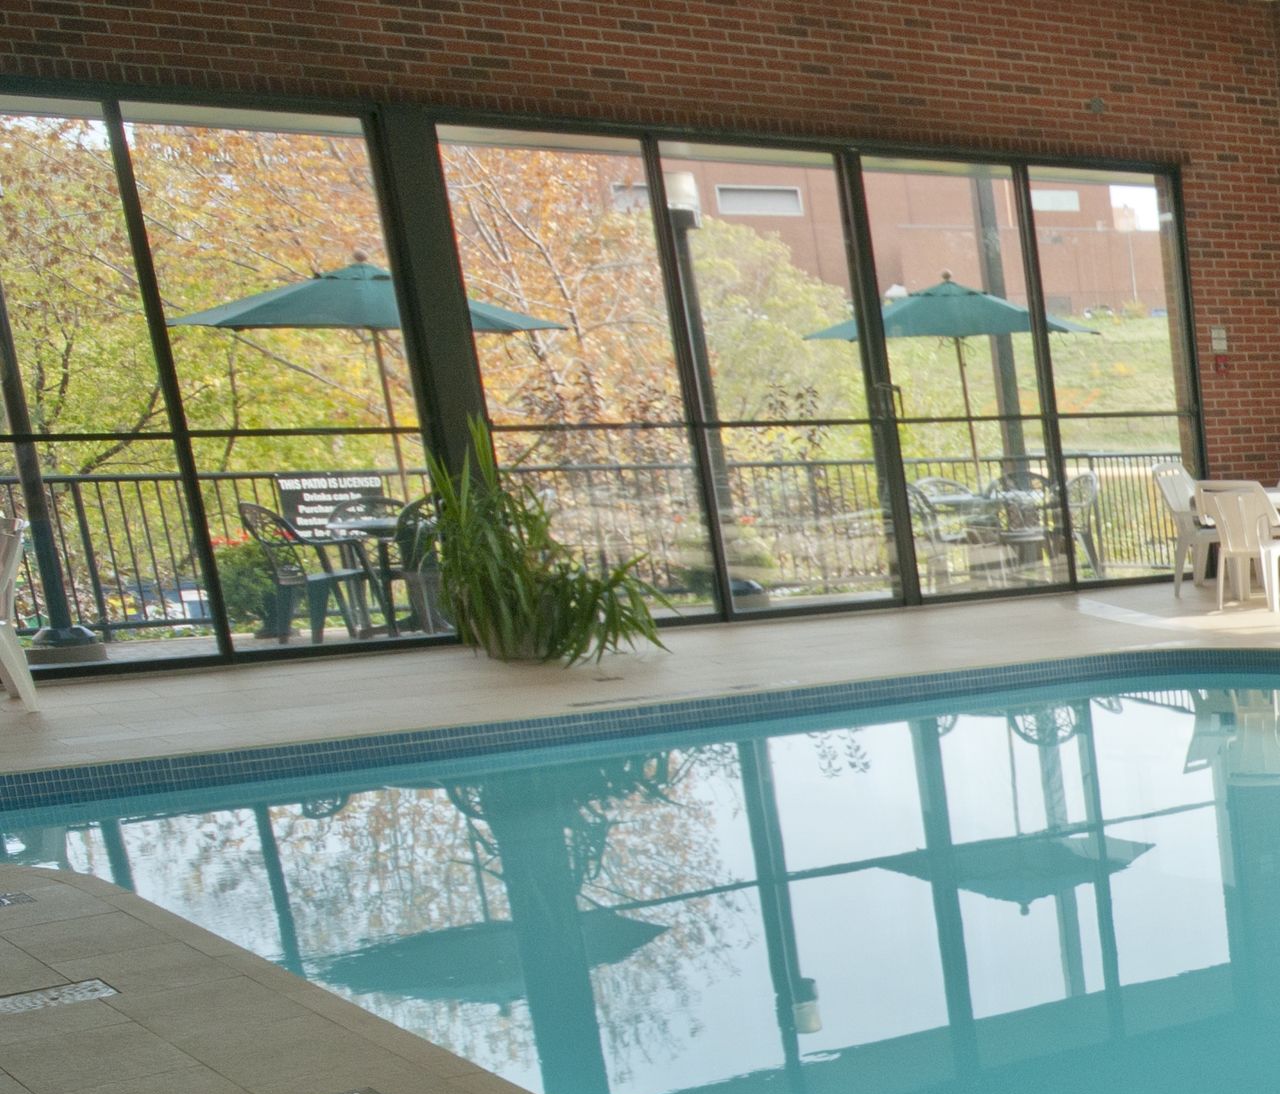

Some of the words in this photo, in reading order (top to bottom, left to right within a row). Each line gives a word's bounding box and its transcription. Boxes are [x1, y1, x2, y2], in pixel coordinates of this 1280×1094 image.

[278, 479, 302, 490] THIS
[301, 478, 328, 489] PATIO
[327, 477, 338, 489] IS
[337, 476, 382, 488] LICENSED
[303, 492, 333, 501] Drinks
[332, 493, 350, 501] can
